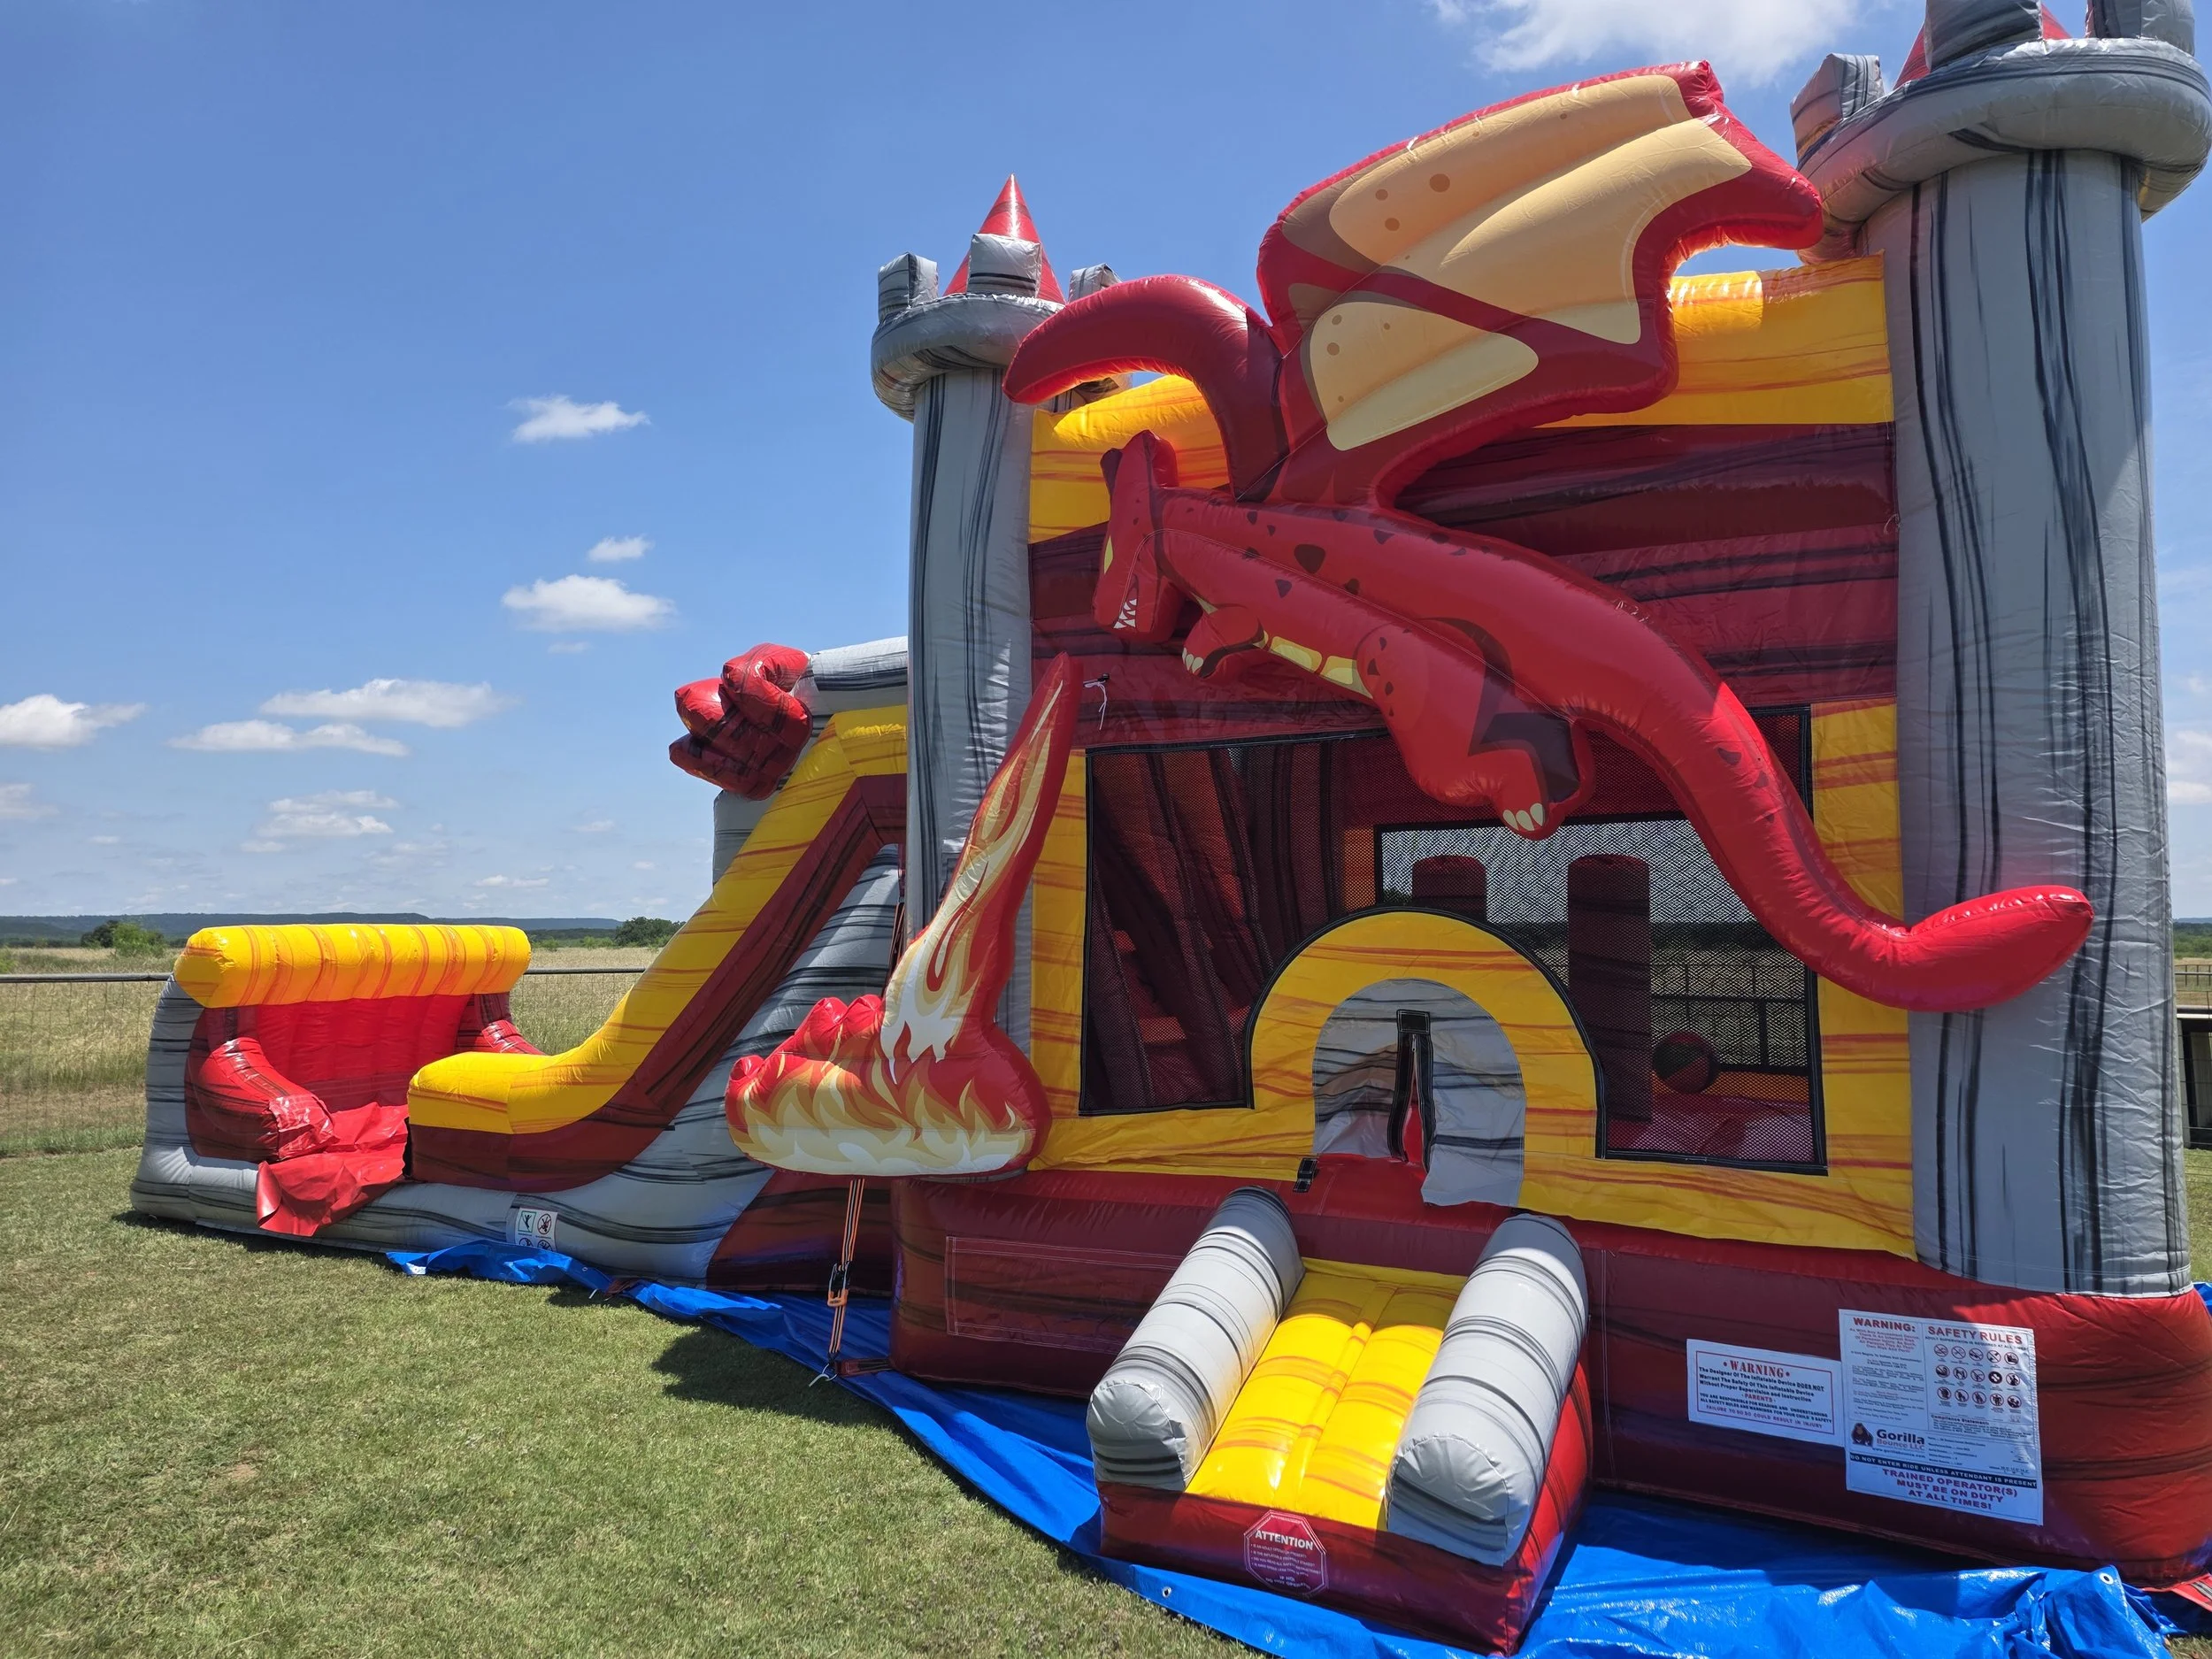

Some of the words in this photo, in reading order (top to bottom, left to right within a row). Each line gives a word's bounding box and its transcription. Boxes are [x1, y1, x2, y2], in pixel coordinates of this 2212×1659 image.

[1854, 1317, 1916, 1333] WARNING:
[1928, 1326, 1977, 1339] SAFETY
[1980, 1331, 2023, 1344] RULES
[1730, 1360, 1784, 1378] WARNING
[1769, 1385, 1794, 1394] Inflatable
[1745, 1394, 1772, 1402] PARENTS
[1782, 1394, 1811, 1402] Instruction
[1877, 1429, 1924, 1444] Gorilla
[1877, 1439, 1908, 1448] Bounce
[1883, 1469, 1933, 1482] TRAINED
[1937, 1478, 2017, 1497] OPERATOR(S)
[1951, 1471, 1993, 1481] ATTENDANT
[1897, 1479, 1929, 1490] MUST
[1971, 1492, 2003, 1502] DUTY
[1926, 1493, 1948, 1502] ALL
[1950, 1497, 1992, 1509] TIMES!
[1255, 1530, 1313, 1550] ATTENTION
